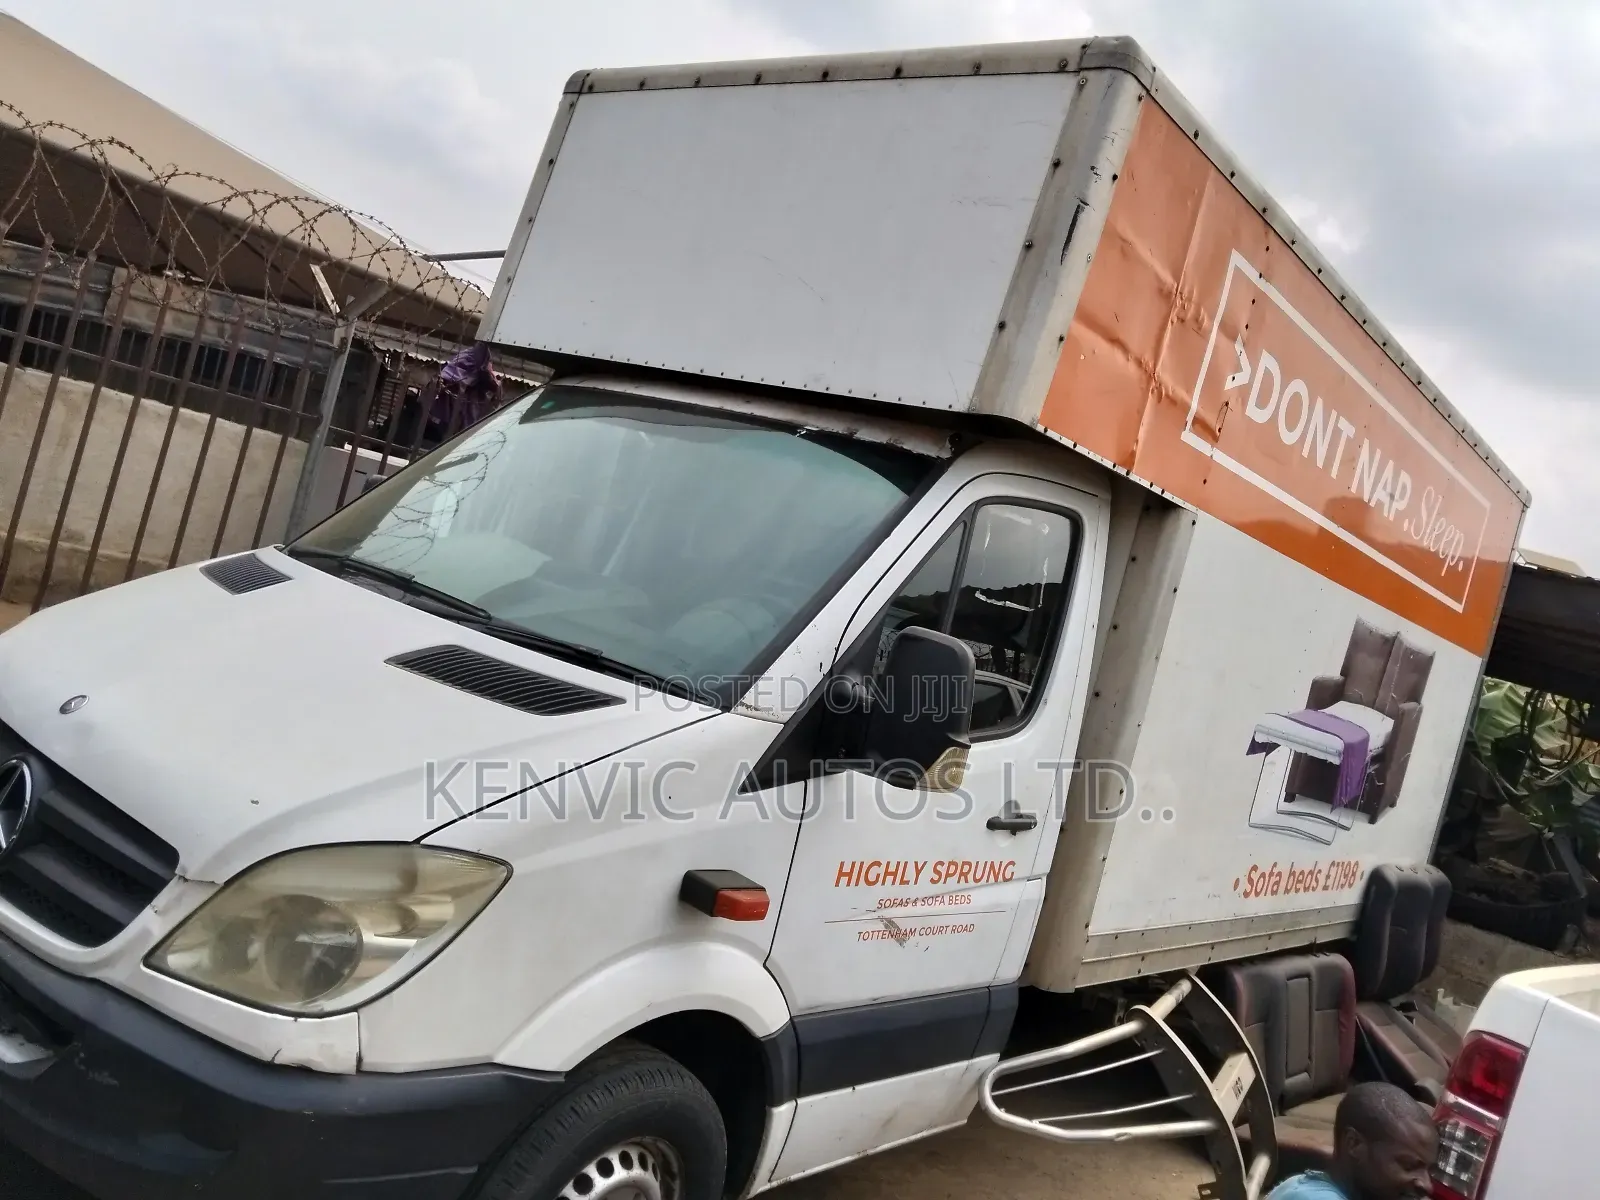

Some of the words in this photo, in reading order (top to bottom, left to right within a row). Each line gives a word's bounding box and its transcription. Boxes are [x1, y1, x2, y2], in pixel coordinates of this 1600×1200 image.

[1245, 349, 1356, 479] DONT
[834, 860, 928, 887] HIGHLY
[930, 860, 1016, 885] SPRUNG
[1243, 861, 1282, 899] Sofa
[1284, 861, 1322, 895] beds
[1322, 860, 1359, 892] £1198
[877, 898, 909, 910] SOFAS
[911, 899, 918, 908] &
[921, 896, 945, 907] SOFA
[948, 894, 972, 906] BEDS
[857, 927, 917, 942] TOTTENHAM
[919, 925, 950, 938] COURT
[951, 923, 975, 934] ROAD
